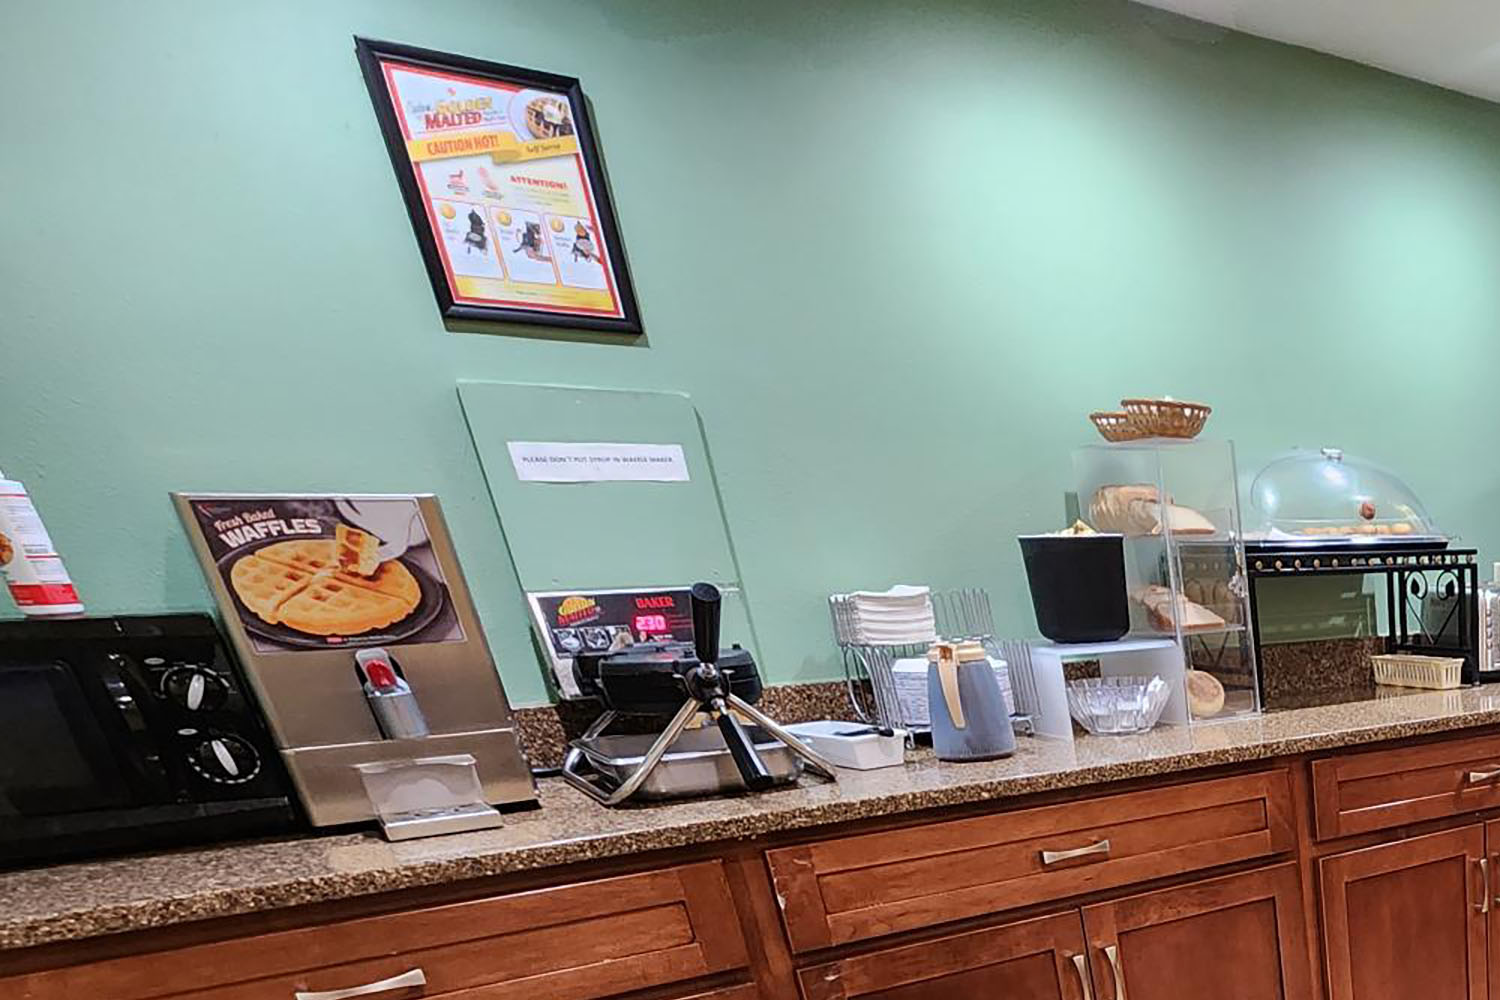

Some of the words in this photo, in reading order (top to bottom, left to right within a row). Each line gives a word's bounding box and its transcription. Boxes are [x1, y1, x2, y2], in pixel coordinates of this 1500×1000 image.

[425, 111, 482, 130] MALTED
[426, 137, 472, 155] CAUTION
[473, 135, 499, 151] HOT!
[214, 514, 244, 532] Fresh
[241, 507, 277, 523] Baked
[218, 518, 322, 549] WAFFLES
[635, 596, 674, 609] BAKER
